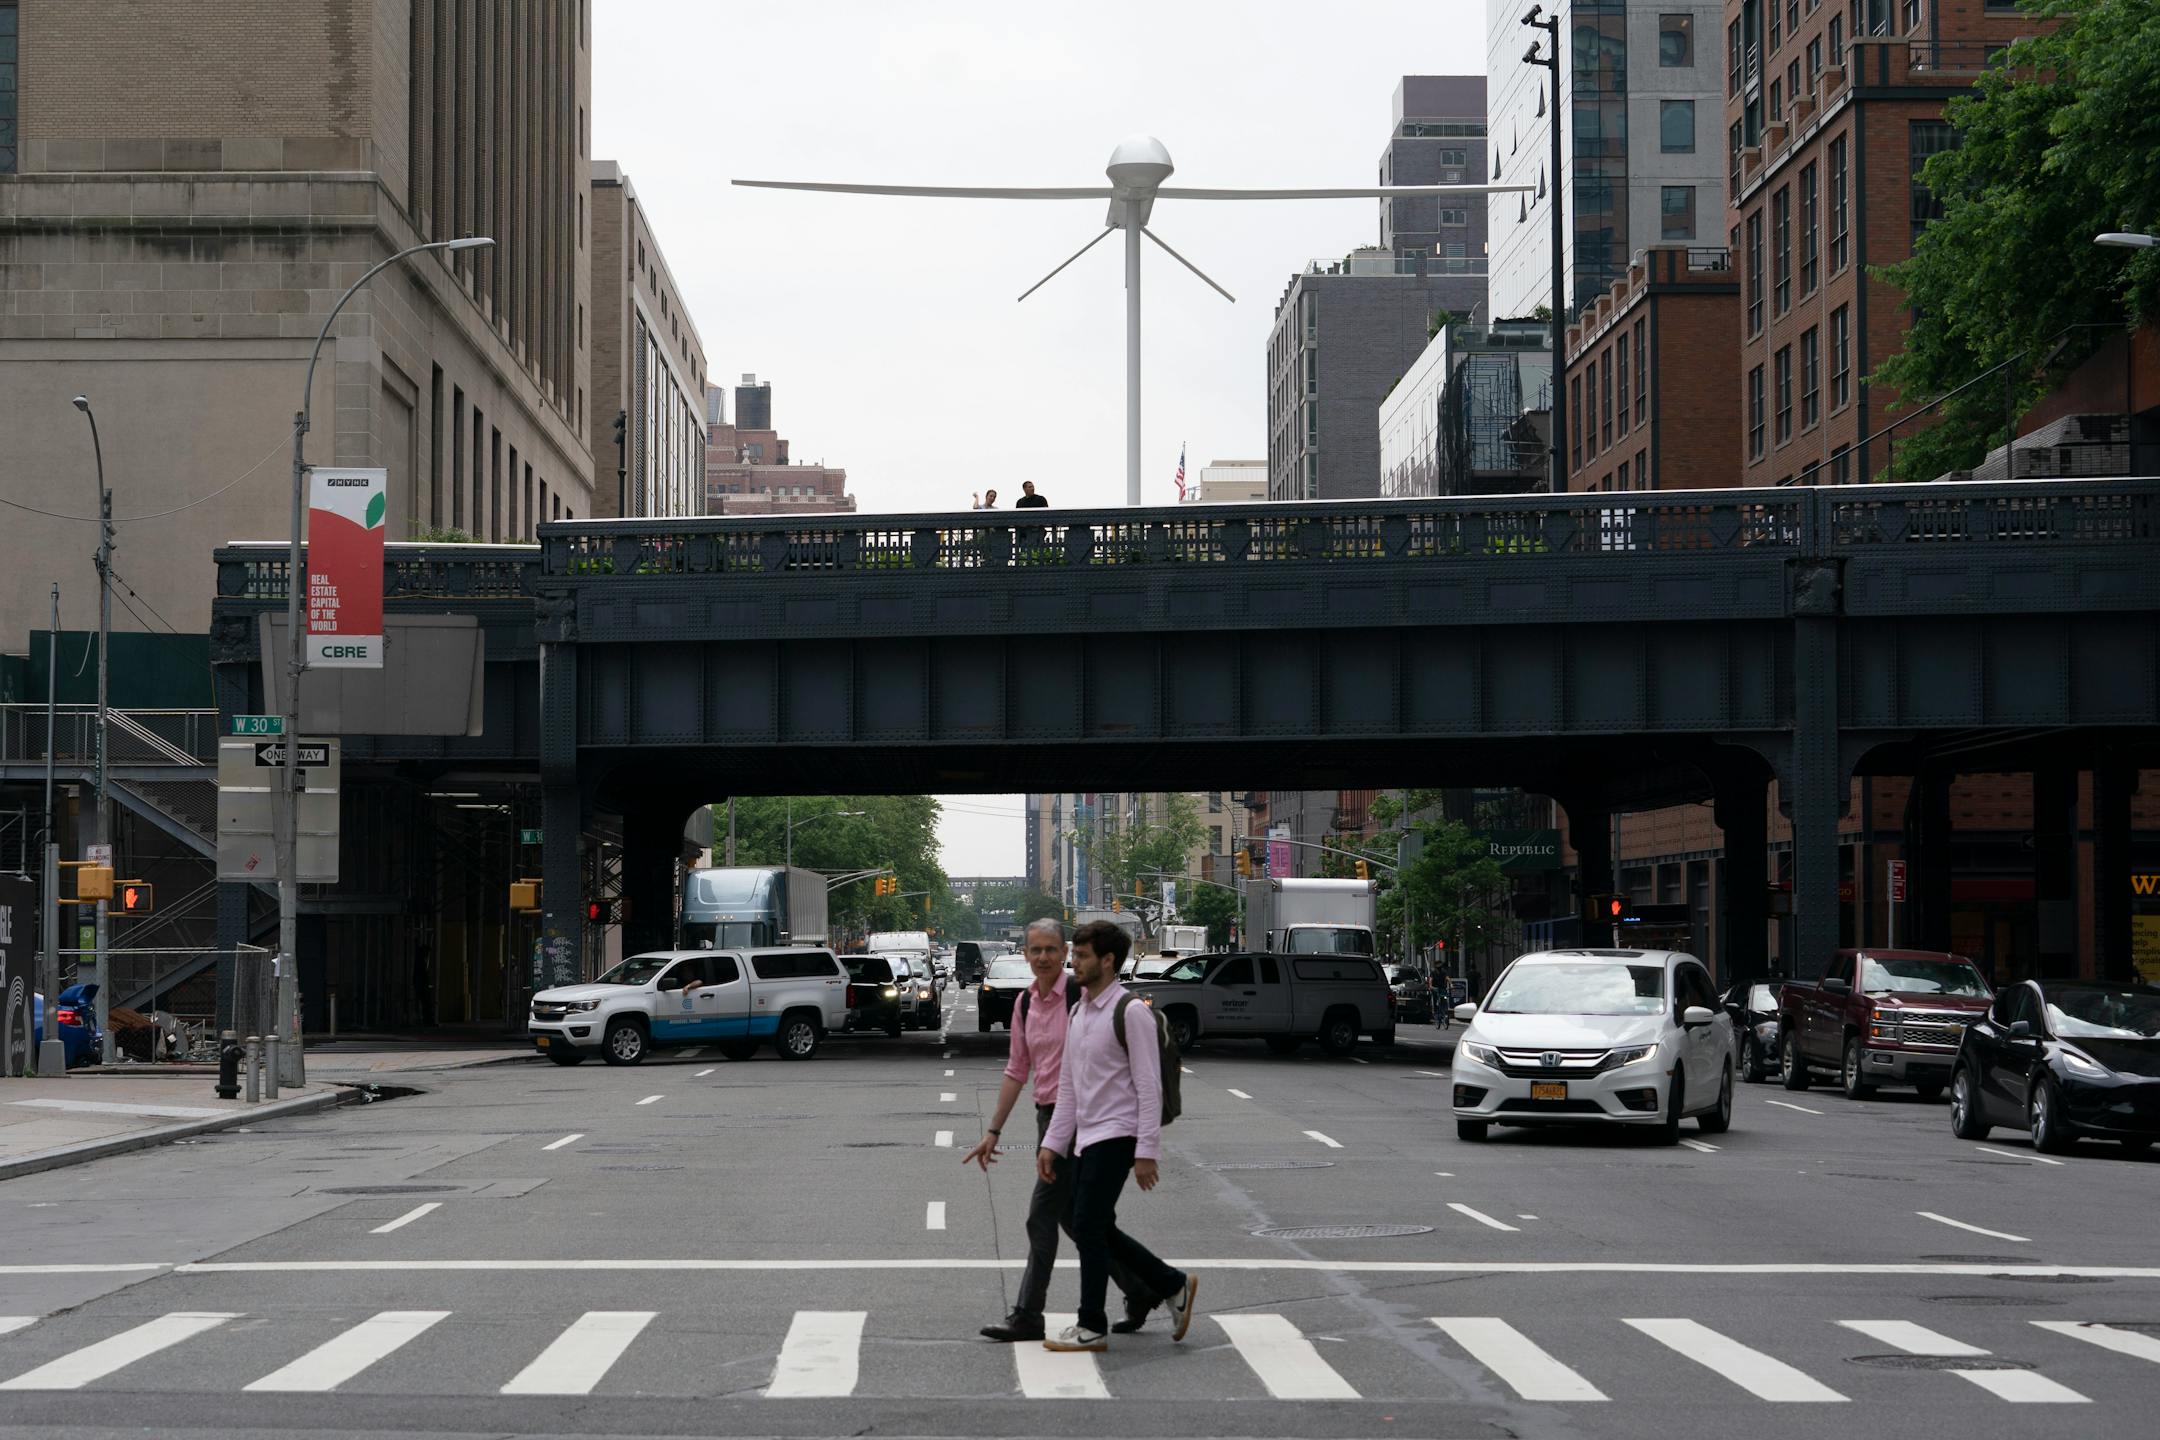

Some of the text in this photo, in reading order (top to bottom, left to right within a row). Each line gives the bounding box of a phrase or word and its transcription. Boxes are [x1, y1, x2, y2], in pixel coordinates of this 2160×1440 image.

[312, 574, 330, 585] REAL
[311, 586, 338, 597] ESTATE
[311, 597, 341, 609] CAPITAL
[311, 609, 337, 620] OF THE
[311, 620, 338, 632] WORLD
[322, 646, 367, 658] CBRE
[235, 718, 282, 732] W 30 ST
[266, 750, 320, 760] ONE WAY
[523, 831, 531, 842] W
[1222, 999, 1247, 1007] verizon
